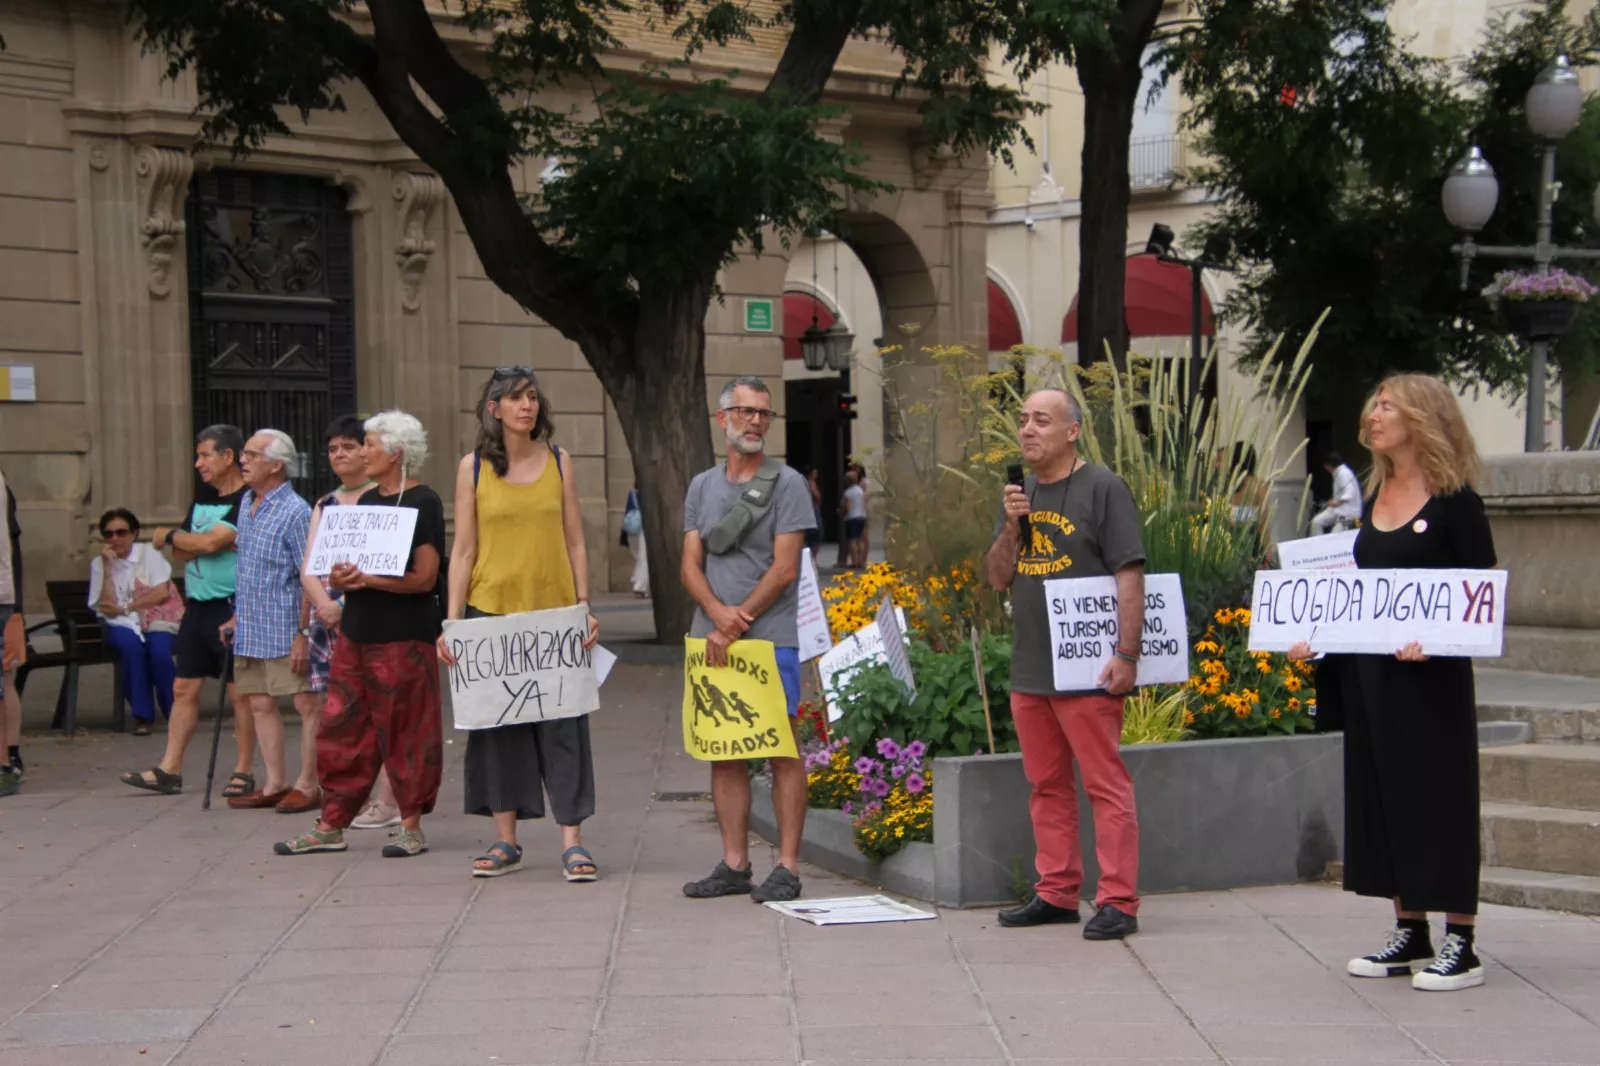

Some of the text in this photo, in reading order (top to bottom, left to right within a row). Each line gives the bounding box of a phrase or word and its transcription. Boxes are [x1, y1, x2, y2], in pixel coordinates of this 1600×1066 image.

[325, 511, 399, 531] NO CABE TANTA
[314, 555, 328, 570] EN
[357, 553, 398, 569] PATERA
[1053, 598, 1066, 614] SI
[1258, 572, 1494, 625] ACOGIDA DIGNA YA
[1058, 619, 1117, 638] TURISMO
[1058, 641, 1101, 660] ABUSO
[1141, 638, 1178, 656] CISMO
